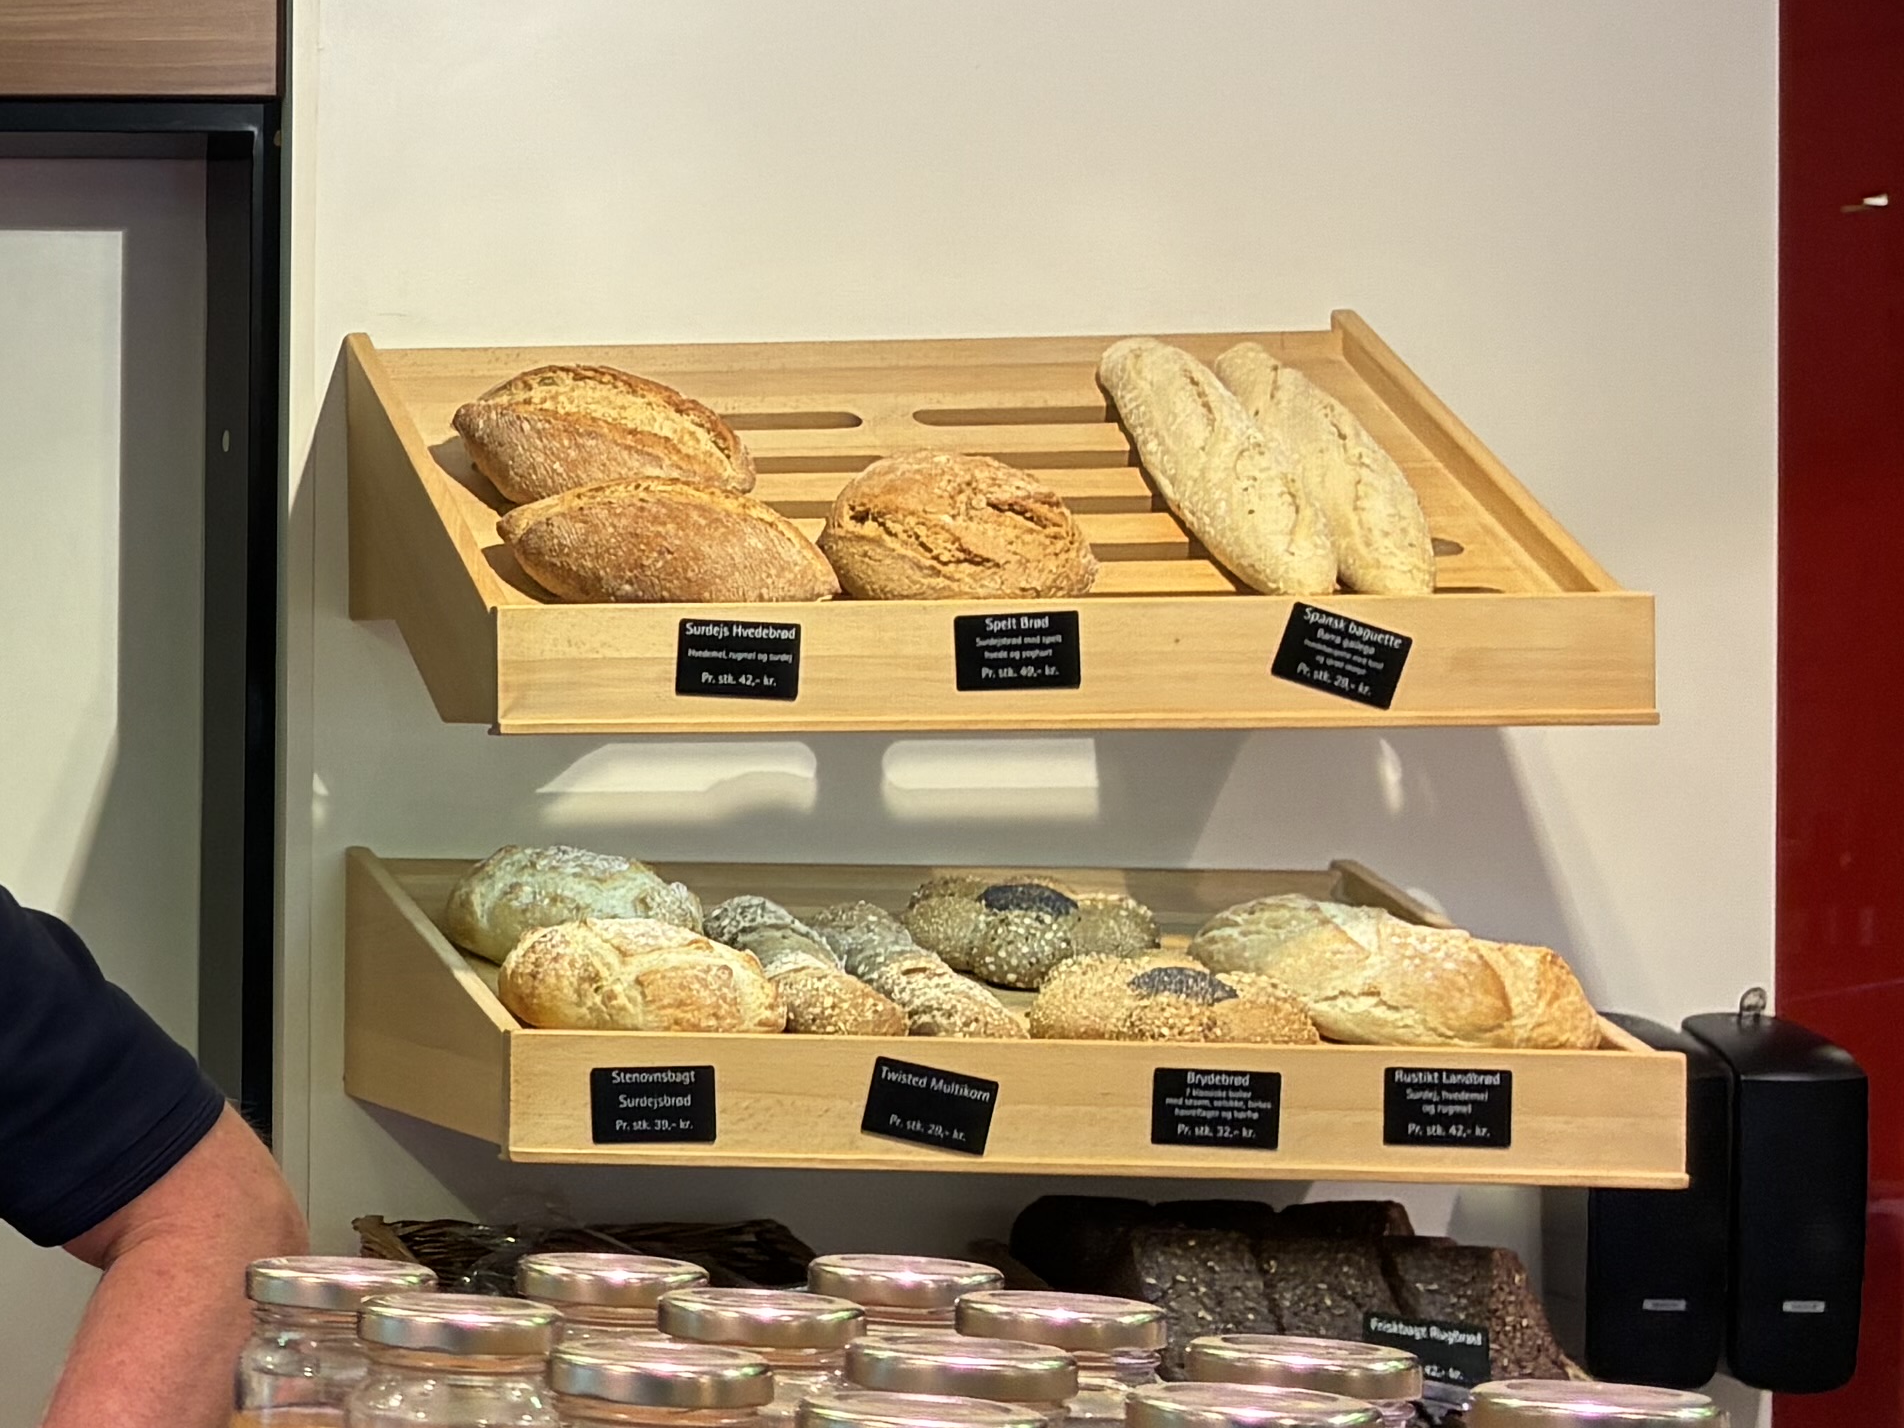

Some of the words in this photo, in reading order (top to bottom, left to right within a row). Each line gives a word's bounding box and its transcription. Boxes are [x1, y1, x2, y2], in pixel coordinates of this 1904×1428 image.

[685, 621, 730, 640] Surdejs
[732, 624, 796, 640] Hvedebrød
[984, 617, 1017, 633] Spelt
[1303, 607, 1347, 632] Spansk
[1348, 621, 1403, 649] baguette
[701, 671, 716, 684] Pr.
[718, 673, 737, 685] stk.
[763, 674, 777, 687] kr.
[981, 666, 996, 679] Pr.
[1296, 661, 1311, 679] Pr.
[1358, 681, 1372, 697] kr.
[611, 1069, 696, 1085] Stenovnsbagt
[880, 1065, 928, 1089] Twisted
[930, 1076, 991, 1103] Multikorn
[1394, 1069, 1439, 1084] Rustikt
[1442, 1069, 1500, 1085] Landbrød
[618, 1093, 692, 1110] Surdejsbrød
[615, 1119, 630, 1131] Pr.
[632, 1119, 651, 1130] stk.
[679, 1118, 694, 1130] kr.
[889, 1113, 904, 1129] Pr.
[906, 1118, 925, 1133] stk.
[952, 1128, 967, 1142] kr.
[1177, 1123, 1192, 1135] Pr.
[1194, 1124, 1213, 1136] stk.
[1242, 1126, 1256, 1138] kr.
[1407, 1122, 1423, 1136] Pr.
[1426, 1124, 1446, 1137] stk.
[1475, 1125, 1491, 1138] kr.
